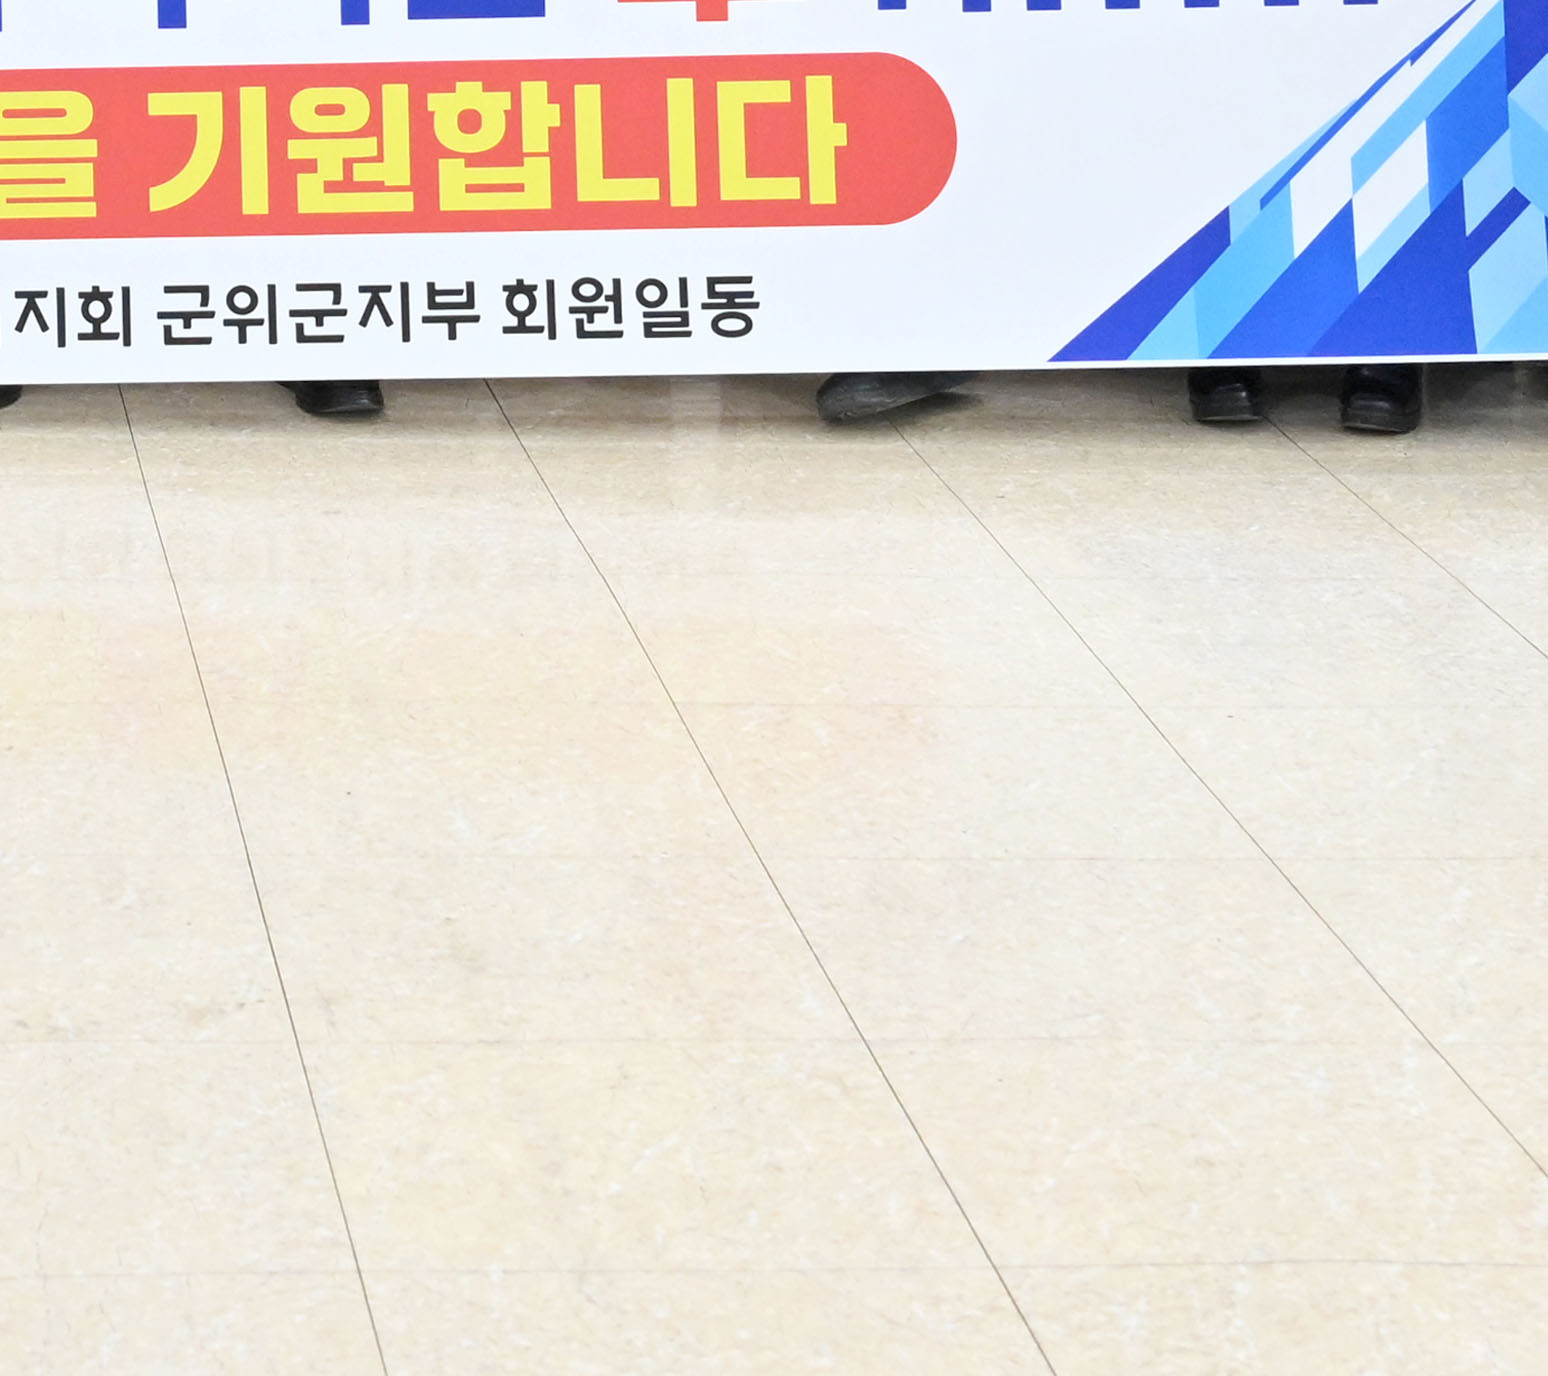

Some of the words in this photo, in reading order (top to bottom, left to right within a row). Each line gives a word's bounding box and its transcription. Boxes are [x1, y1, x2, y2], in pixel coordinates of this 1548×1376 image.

[146, 72, 848, 214] 기원합니다
[156, 279, 483, 350] 군위군지부
[500, 274, 760, 344] 회원일동
